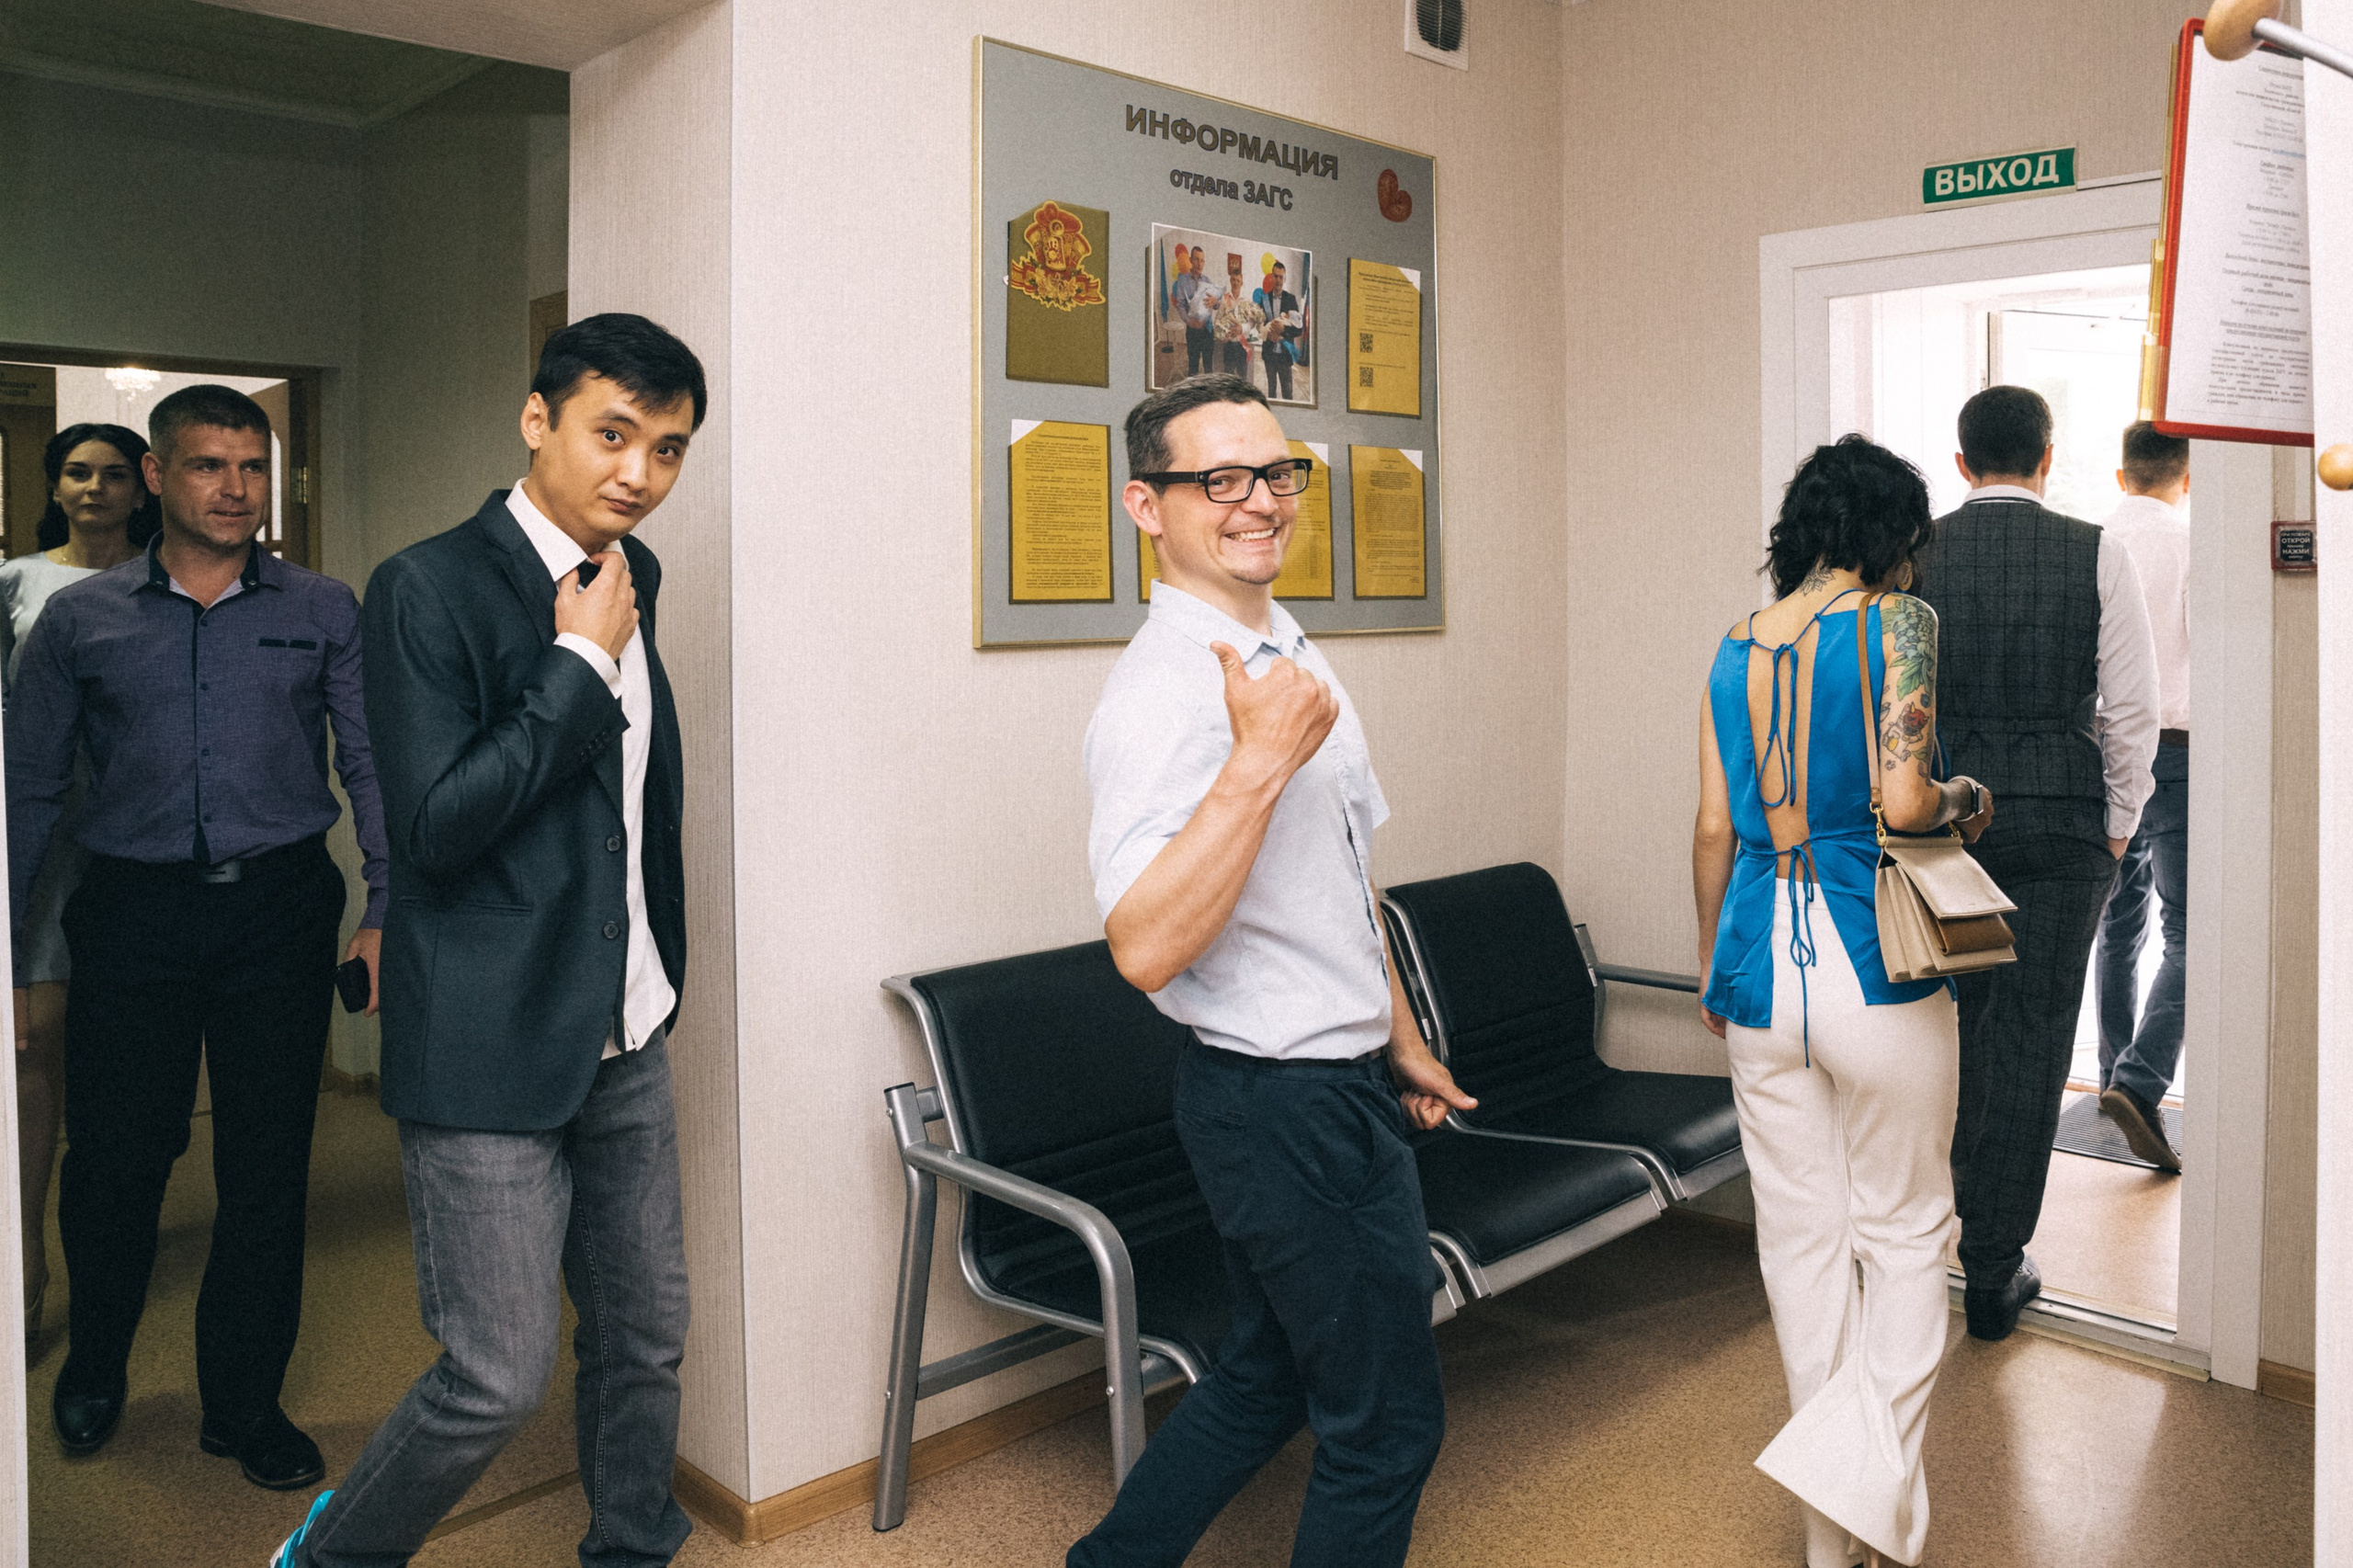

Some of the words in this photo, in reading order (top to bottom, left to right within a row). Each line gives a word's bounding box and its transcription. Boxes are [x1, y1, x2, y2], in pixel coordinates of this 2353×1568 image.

[1126, 104, 1338, 180] ИНФОРМАЦИЯ
[1169, 168, 1239, 200] отдела
[1243, 179, 1293, 211] ЗАГС
[1935, 153, 2060, 197] ВЫХОД
